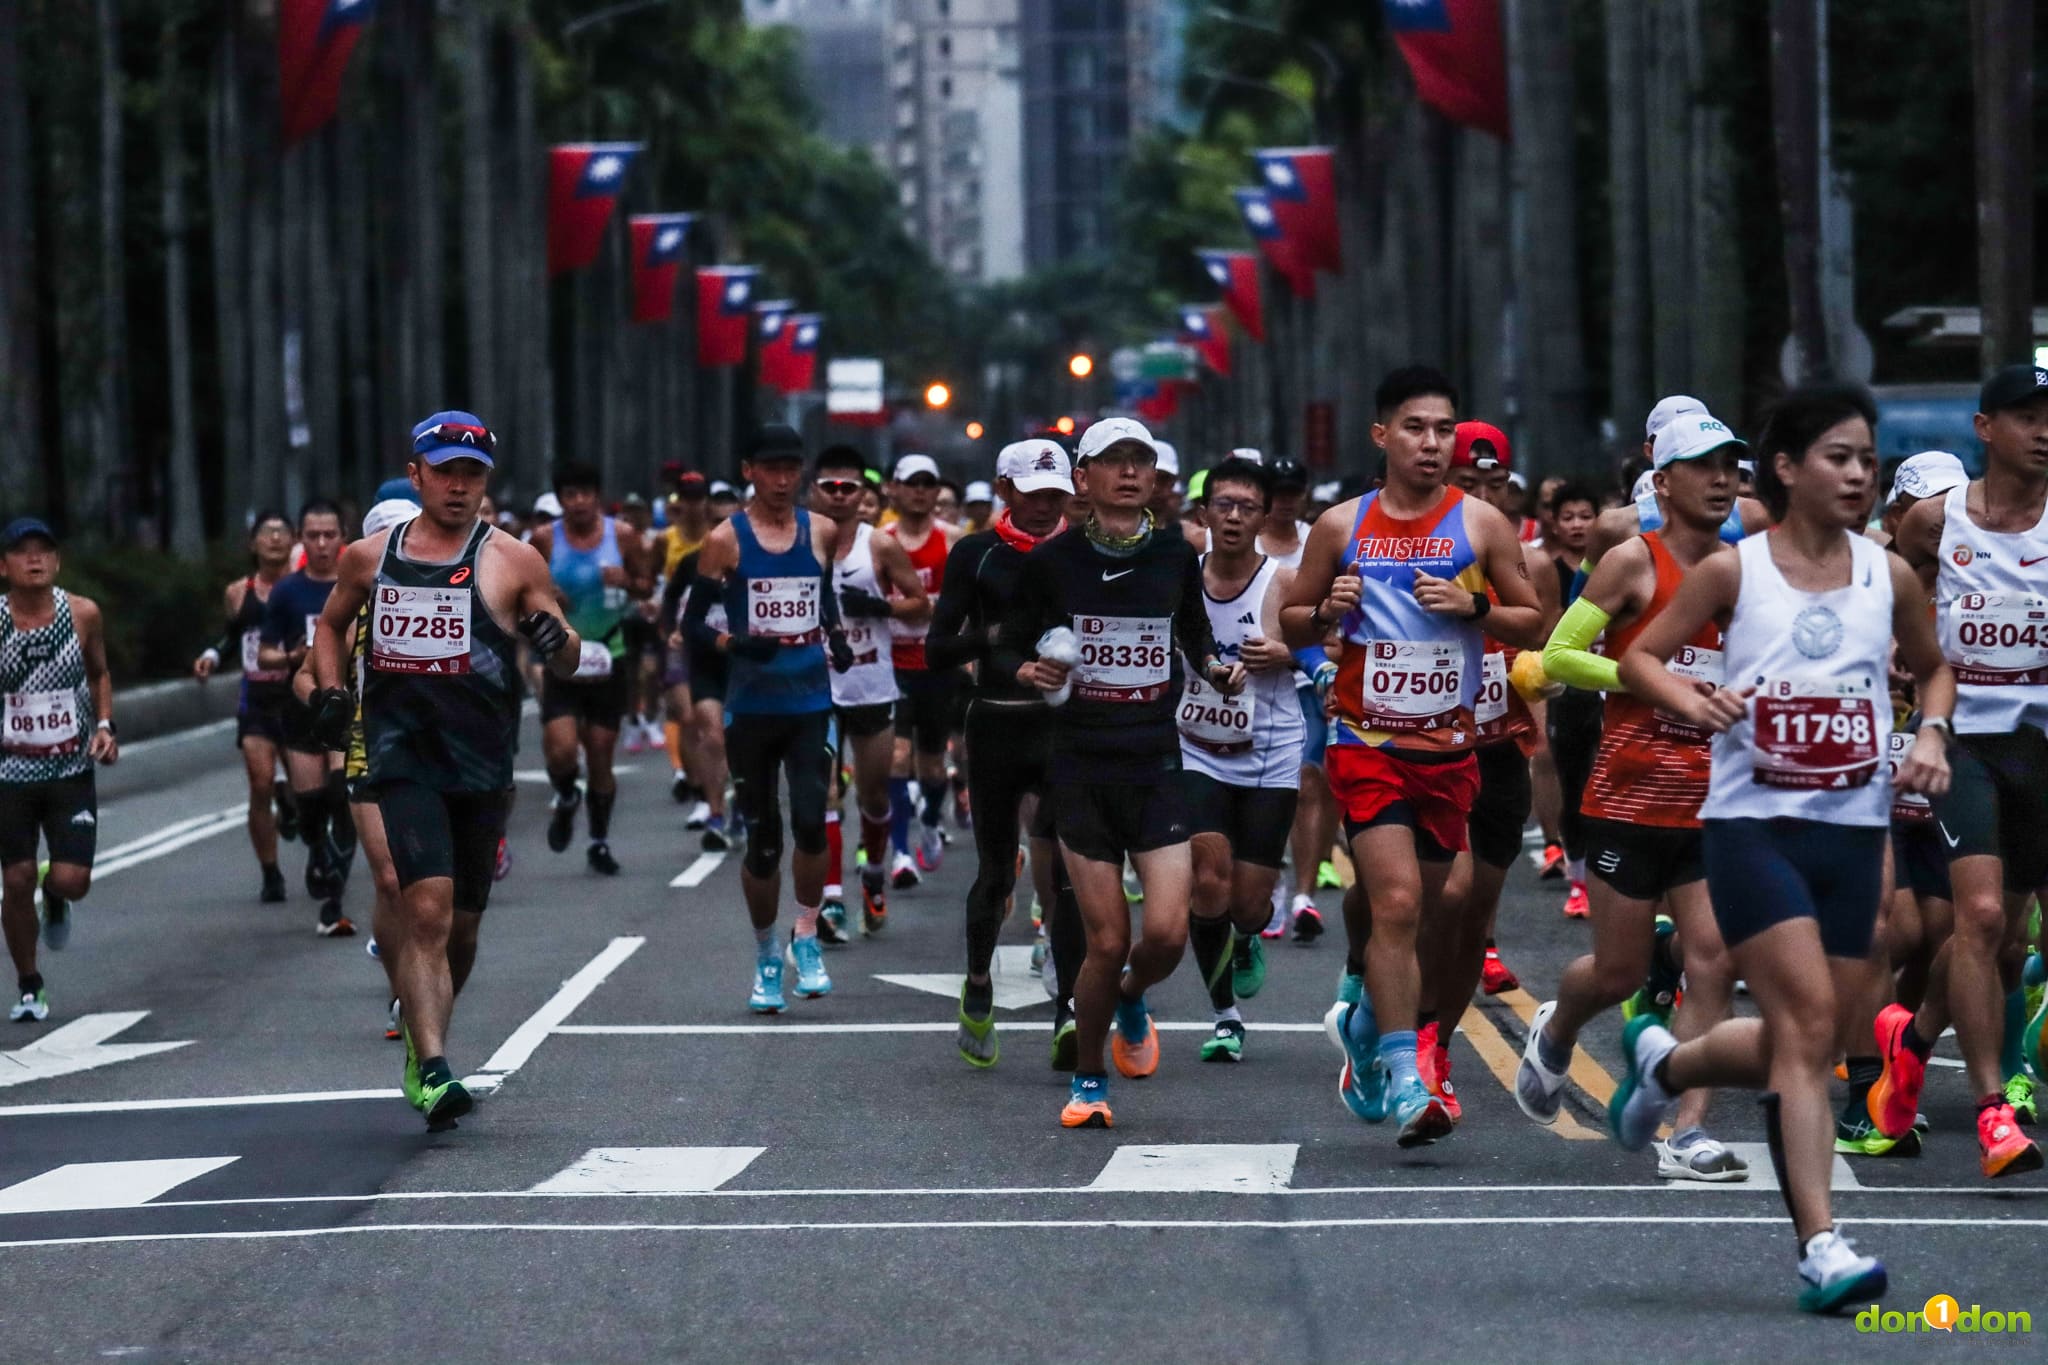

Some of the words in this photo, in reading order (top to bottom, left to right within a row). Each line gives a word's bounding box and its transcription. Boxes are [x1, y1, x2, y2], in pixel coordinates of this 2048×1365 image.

[1356, 537, 1455, 560] FINISHER
[1976, 551, 1991, 559] NN
[755, 600, 815, 618] 08381
[380, 614, 465, 639] 07285
[1959, 622, 2048, 648] 08043
[1081, 644, 1165, 667] 08336
[1372, 671, 1459, 695] 07506
[1780, 681, 1791, 696] B
[11, 710, 72, 732] 08184
[1181, 703, 1248, 730] 07400
[1771, 713, 1870, 744] 11798
